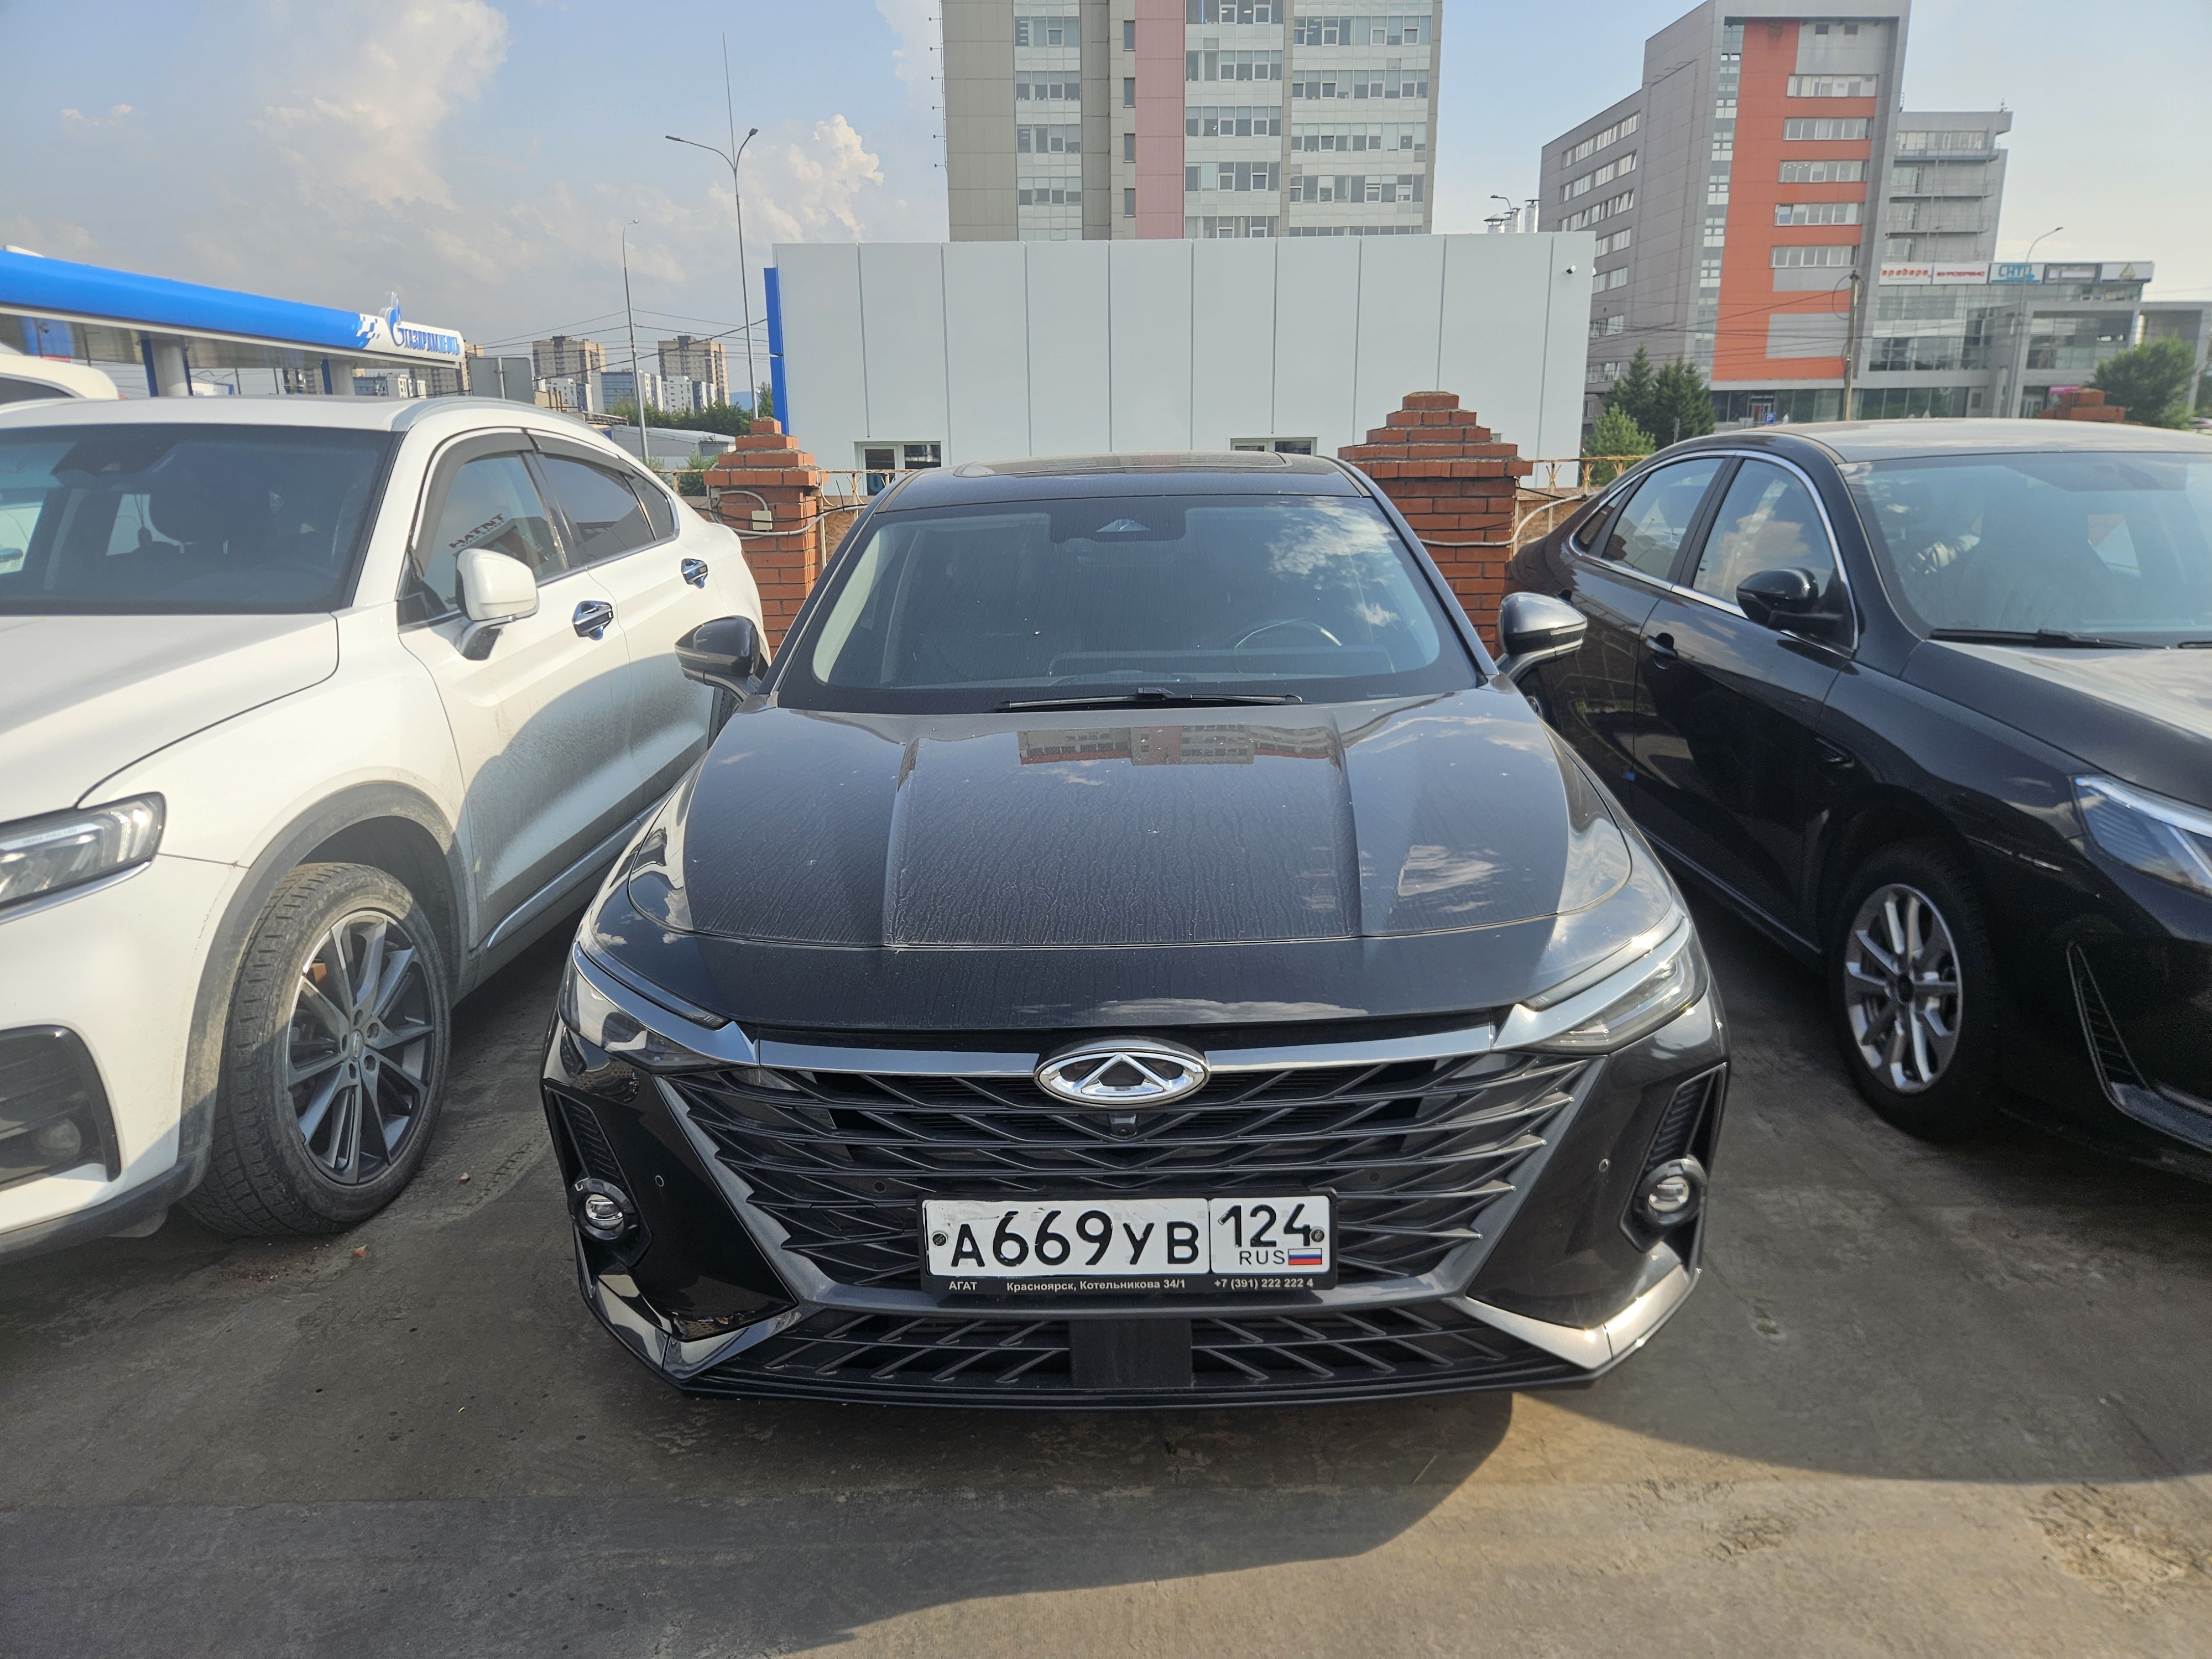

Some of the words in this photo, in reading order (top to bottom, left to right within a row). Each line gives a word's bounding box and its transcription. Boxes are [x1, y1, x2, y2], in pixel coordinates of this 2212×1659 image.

[951, 1209, 1199, 1267] А669УВ
[1218, 1203, 1311, 1248] 124
[1239, 1250, 1285, 1265] RUS
[948, 1281, 978, 1290] АГАТ
[1006, 1282, 1077, 1292] Красноярск,
[1079, 1280, 1160, 1290] Котельникова
[1163, 1279, 1186, 1288] 34/1
[1214, 1279, 1227, 1288] +7
[1230, 1278, 1258, 1290] (391)
[1261, 1278, 1280, 1288] 222
[1284, 1278, 1303, 1288] 222
[1306, 1278, 1314, 1287] 4
